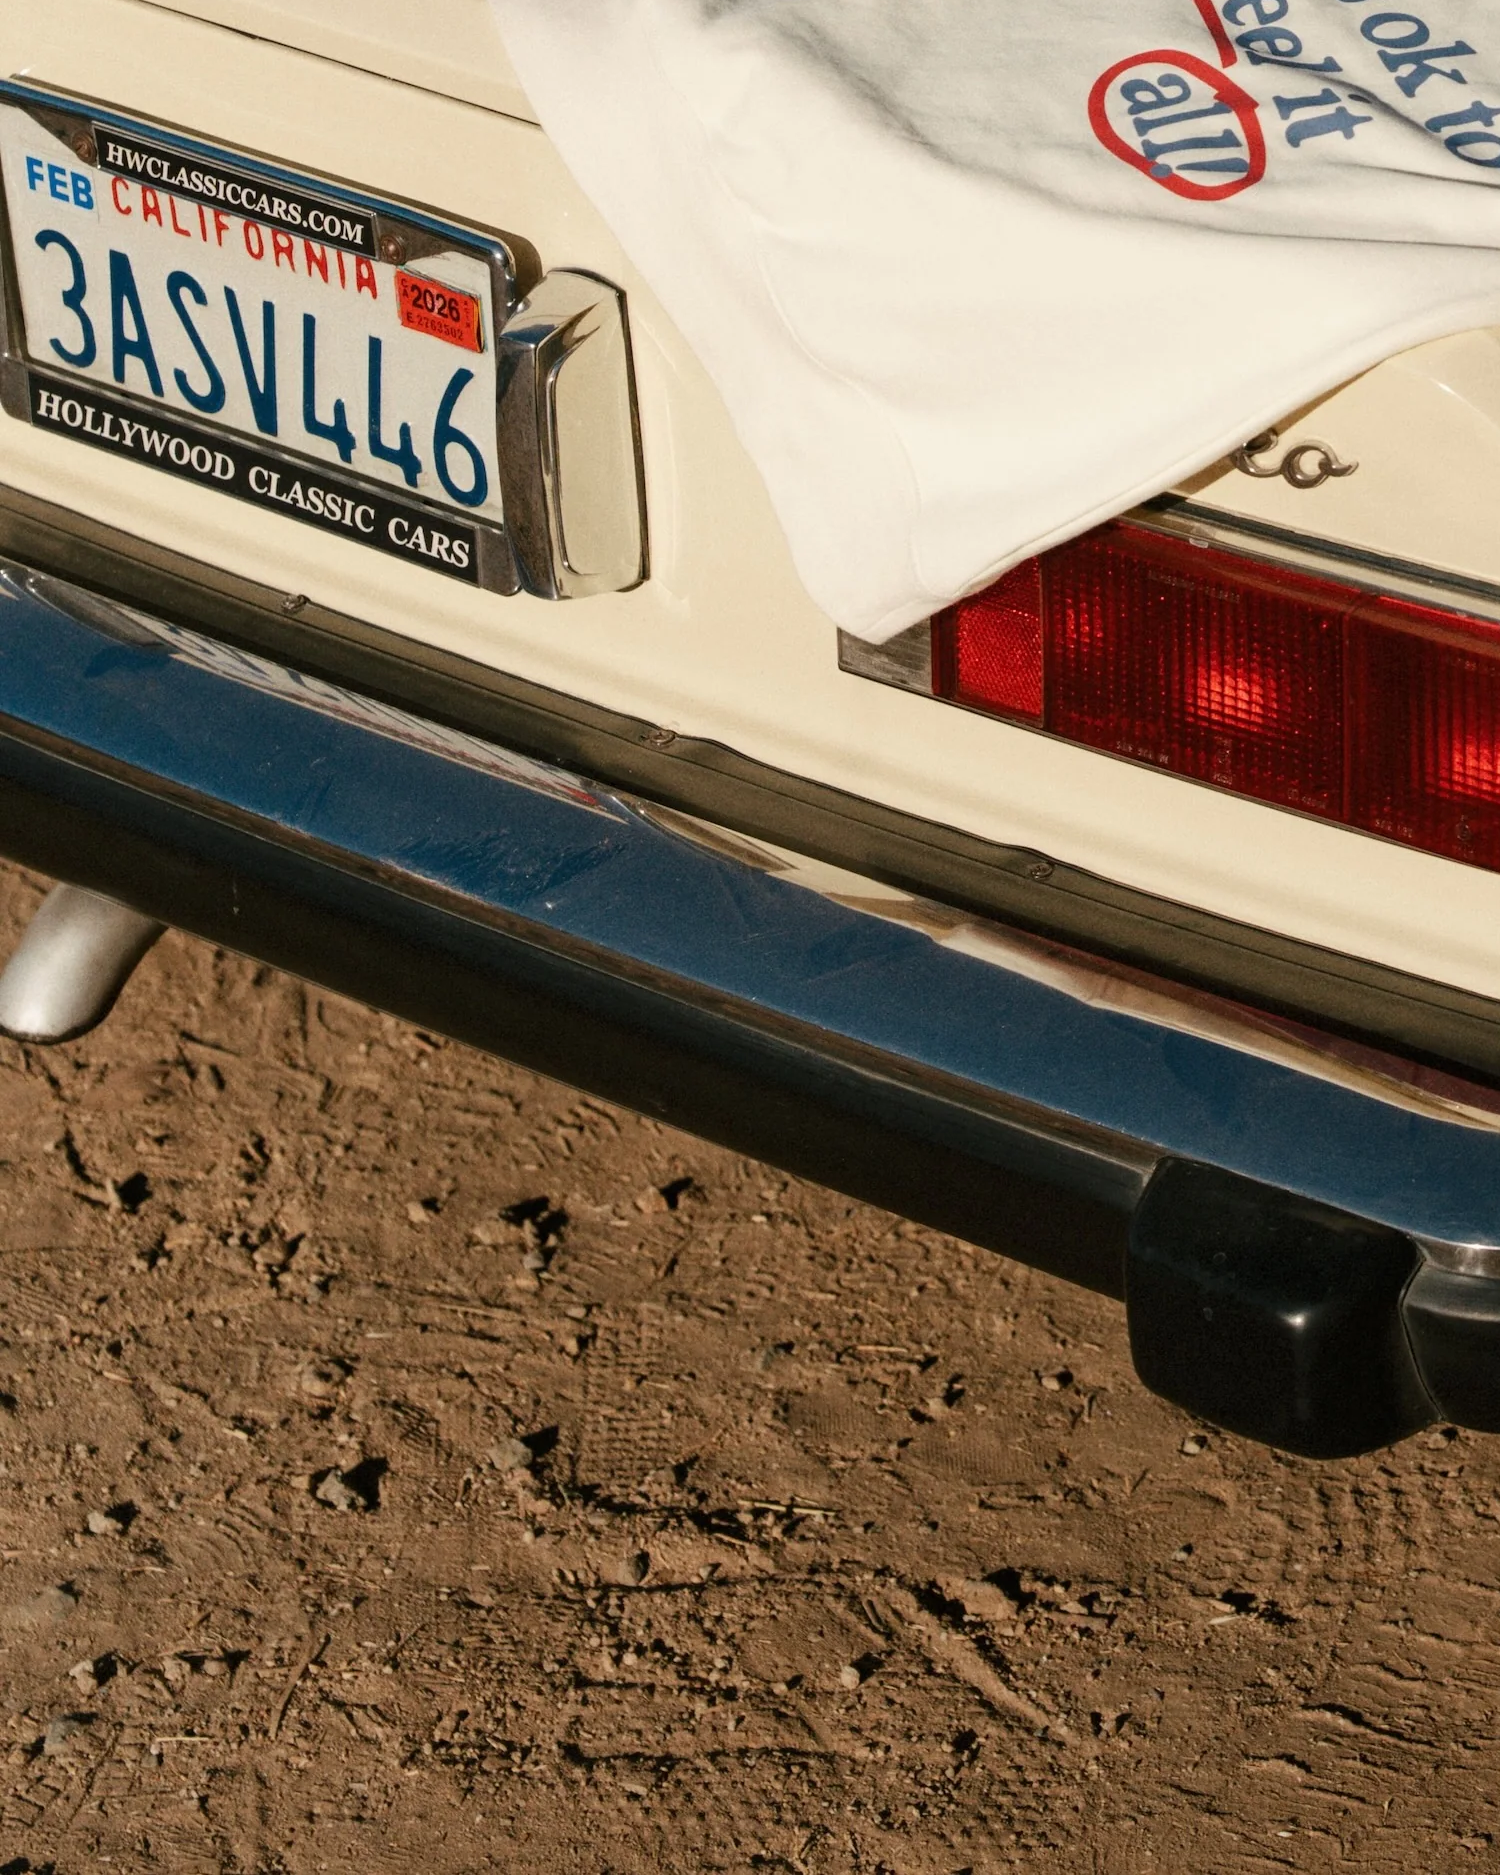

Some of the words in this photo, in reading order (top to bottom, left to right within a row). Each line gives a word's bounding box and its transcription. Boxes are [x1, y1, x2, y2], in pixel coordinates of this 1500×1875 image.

[1360, 12, 1477, 98] ok
[1119, 72, 1251, 179] all!
[1272, 87, 1374, 148] it
[25, 156, 95, 211] FEB
[106, 142, 365, 245] HWCLASSICCARS.COM
[110, 175, 378, 300] CALIFORNIA
[410, 283, 461, 323] 2026
[34, 228, 490, 508] 3ASV446
[37, 388, 236, 482] HOLLYWOOD
[248, 464, 376, 534] CLASSIC
[387, 517, 471, 570] CARS
